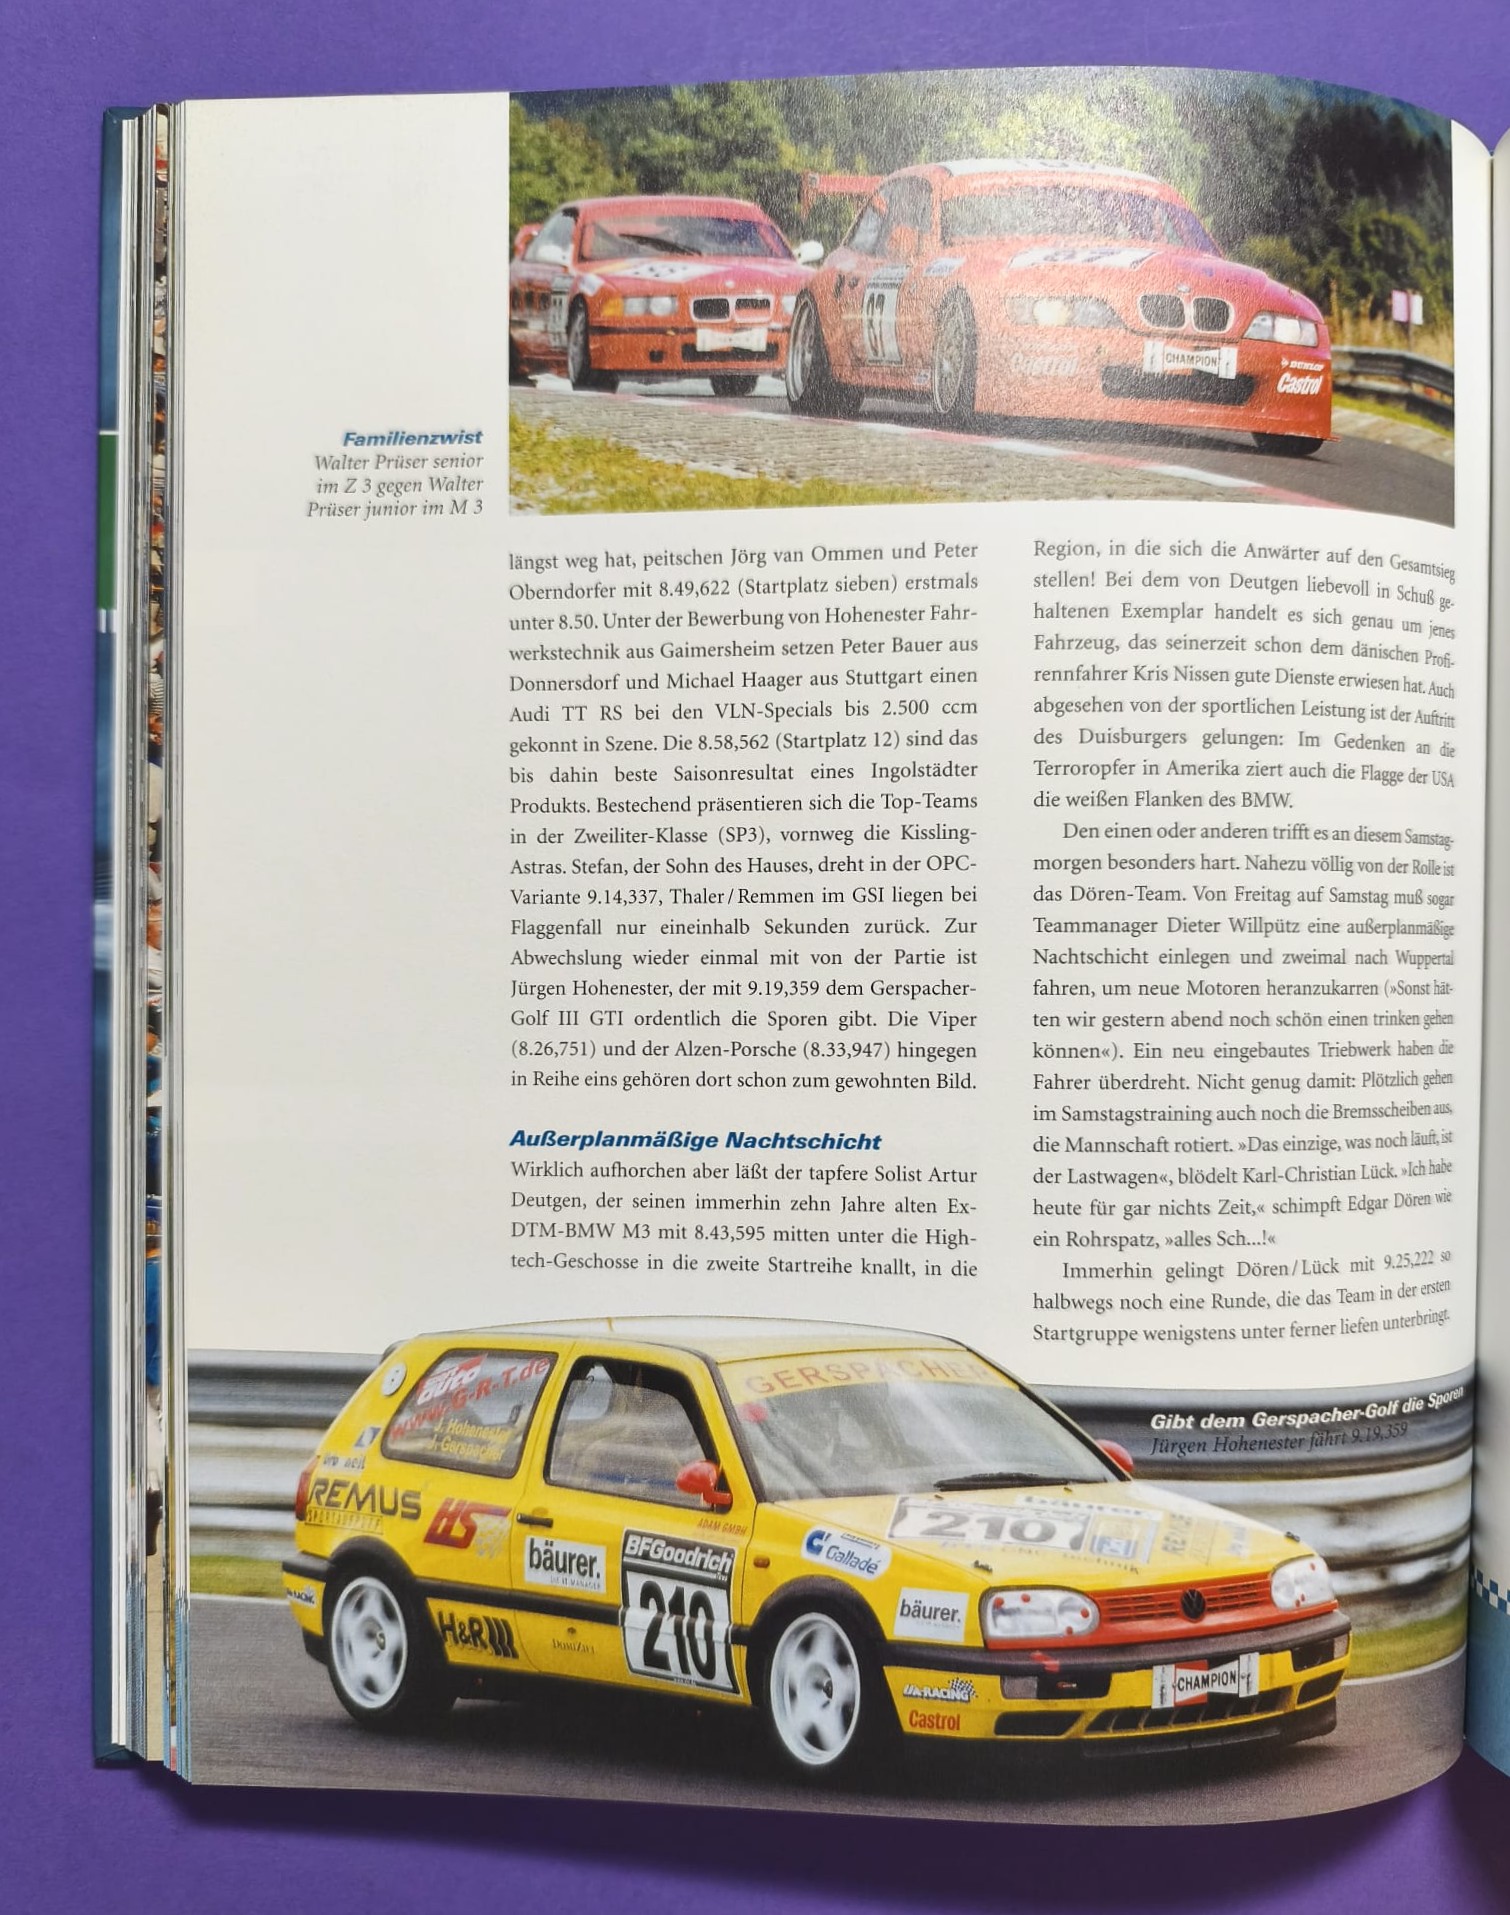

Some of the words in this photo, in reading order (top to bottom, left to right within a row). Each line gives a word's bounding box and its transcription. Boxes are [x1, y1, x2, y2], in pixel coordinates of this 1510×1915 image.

[1165, 352, 1218, 368] CHAMPION
[1276, 372, 1323, 396] Castrol
[342, 430, 484, 447] Familienzwist
[314, 453, 370, 471] Walter
[374, 453, 429, 470] Prüser
[432, 452, 484, 469] senior
[316, 478, 339, 494] im
[344, 477, 358, 494] Z
[362, 478, 372, 493] 3
[376, 481, 422, 498] gegen
[428, 475, 484, 492] Walter
[307, 500, 361, 518] Prüser
[364, 500, 418, 522] junior
[422, 499, 444, 515] im
[449, 498, 470, 515] M
[473, 498, 483, 515] 3
[508, 553, 559, 574] längst
[564, 557, 599, 573] weg
[604, 551, 637, 569] hat,
[642, 548, 723, 571] peitschen
[730, 548, 767, 568] Jörg
[773, 551, 804, 562] van
[811, 546, 884, 561] Ommen
[891, 541, 927, 559] und
[934, 542, 979, 558] Peter
[1033, 540, 1101, 561] Region,
[1109, 540, 1126, 555] in
[1134, 539, 1162, 555] die
[1168, 540, 1203, 556] sich
[1210, 540, 1237, 557] die
[1243, 543, 1321, 561] Anwärter
[1326, 548, 1353, 563] auf
[1357, 549, 1384, 567] den
[1389, 554, 1456, 585] Gesamtsieg
[508, 643, 621, 661] werkstechnik
[625, 648, 655, 659] aus
[659, 640, 776, 658] Gaimersheim
[781, 642, 835, 656] setzen
[840, 639, 886, 654] Peter
[891, 637, 944, 653] Bauer
[948, 640, 979, 651] aus
[1033, 728, 1063, 744] des
[1078, 727, 1188, 749] Duisburgers
[1201, 728, 1284, 750] gelungen:
[1298, 731, 1321, 747] Im
[1333, 733, 1406, 752] Gedenken
[1415, 743, 1431, 754] an
[1439, 741, 1456, 758] die
[509, 767, 534, 783] bis
[549, 766, 599, 783] dahin
[614, 766, 658, 782] beste
[673, 763, 795, 781] Saisonresultat
[810, 763, 855, 779] eines
[871, 760, 979, 783] Ingolstädter
[1033, 791, 1061, 807] die
[1065, 790, 1129, 807] weißen
[1134, 790, 1204, 807] Flanken
[1208, 791, 1237, 807] des
[1240, 792, 1294, 808] BMW.
[510, 828, 527, 844] in
[536, 828, 565, 844] der
[573, 826, 709, 844] Zweiliter-Klasse
[718, 826, 771, 845] (SP3),
[779, 830, 855, 846] vornweg
[863, 824, 891, 840] die
[900, 823, 977, 844] Kissling-
[510, 919, 602, 939] Flaggenfall
[616, 924, 647, 934] nur
[660, 918, 751, 934] eineinhalb
[763, 918, 850, 934] Sekunden
[863, 917, 930, 934] zurück.
[944, 918, 978, 933] Zur
[1032, 917, 1159, 937] Teammanager
[1166, 917, 1222, 933] Dieter
[1227, 916, 1301, 938] Willpütz
[1307, 918, 1341, 933] eine
[1346, 918, 1456, 940] außerplanmäßige
[510, 980, 567, 1000] Jürgen
[572, 979, 673, 997] Hohenester,
[678, 979, 707, 995] der
[712, 980, 743, 995] mit
[747, 980, 820, 998] 9.19,359
[825, 979, 865, 995] dem
[870, 979, 977, 1000] Gerspacher-
[510, 1070, 528, 1086] in
[532, 1070, 580, 1086] Reihe
[584, 1071, 618, 1086] eins
[622, 1071, 691, 1091] gehören
[695, 1071, 733, 1087] dort
[737, 1071, 787, 1087] schon
[792, 1077, 831, 1088] zum
[835, 1072, 931, 1093] gewohnten
[936, 1072, 977, 1089] Bild.
[1032, 1073, 1092, 1090] Fahrer
[1098, 1073, 1191, 1090] überdreht.
[1196, 1073, 1246, 1090] Nicht
[1250, 1078, 1301, 1094] genug
[1306, 1072, 1357, 1089] damit:
[1361, 1070, 1420, 1087] Plötzlich
[1422, 1069, 1454, 1090] gehen
[508, 1130, 720, 1152] Außerplanmäßige
[724, 1132, 883, 1150] Nachtschicht
[510, 1222, 616, 1238] DTM-BMW
[622, 1223, 651, 1238] M3
[657, 1224, 688, 1239] mit
[694, 1225, 766, 1242] 8.43,595
[772, 1226, 830, 1242] mitten
[837, 1230, 885, 1243] unter
[891, 1227, 919, 1244] die
[925, 1229, 977, 1250] High-
[1032, 1230, 1061, 1247] ein
[1065, 1230, 1161, 1252] Rohrspatz,
[1164, 1230, 1212, 1247] »alles
[1216, 1229, 1276, 1246] Sch...!«
[1032, 1324, 1139, 1346] Startgruppe
[1142, 1325, 1237, 1346] wenigstens
[1240, 1326, 1286, 1339] unter
[1289, 1321, 1337, 1338] ferner
[1340, 1317, 1379, 1334] liefen
[1382, 1309, 1450, 1330] unterbringt.
[1150, 1412, 1195, 1431] Gibt
[1199, 1412, 1245, 1429] dem
[1251, 1399, 1399, 1430] Gerspacher-Golf
[1401, 1396, 1424, 1415] die
[1427, 1385, 1464, 1410] Sporen
[1150, 1436, 1207, 1459] Jürgen
[1213, 1432, 1306, 1454] Hohenester
[1306, 1429, 1347, 1452] fährt
[309, 1477, 422, 1520] REMUS
[919, 1510, 1058, 1543] 210
[528, 1537, 601, 1579] bäurer.
[625, 1534, 735, 1574] BFGoodrich
[825, 1543, 882, 1576] Galladé
[899, 1597, 962, 1623] bäurer.
[437, 1610, 488, 1651] H&R
[640, 1580, 716, 1680] 210
[1176, 1669, 1237, 1692] CHAMPION
[908, 1709, 961, 1731] Castrol
